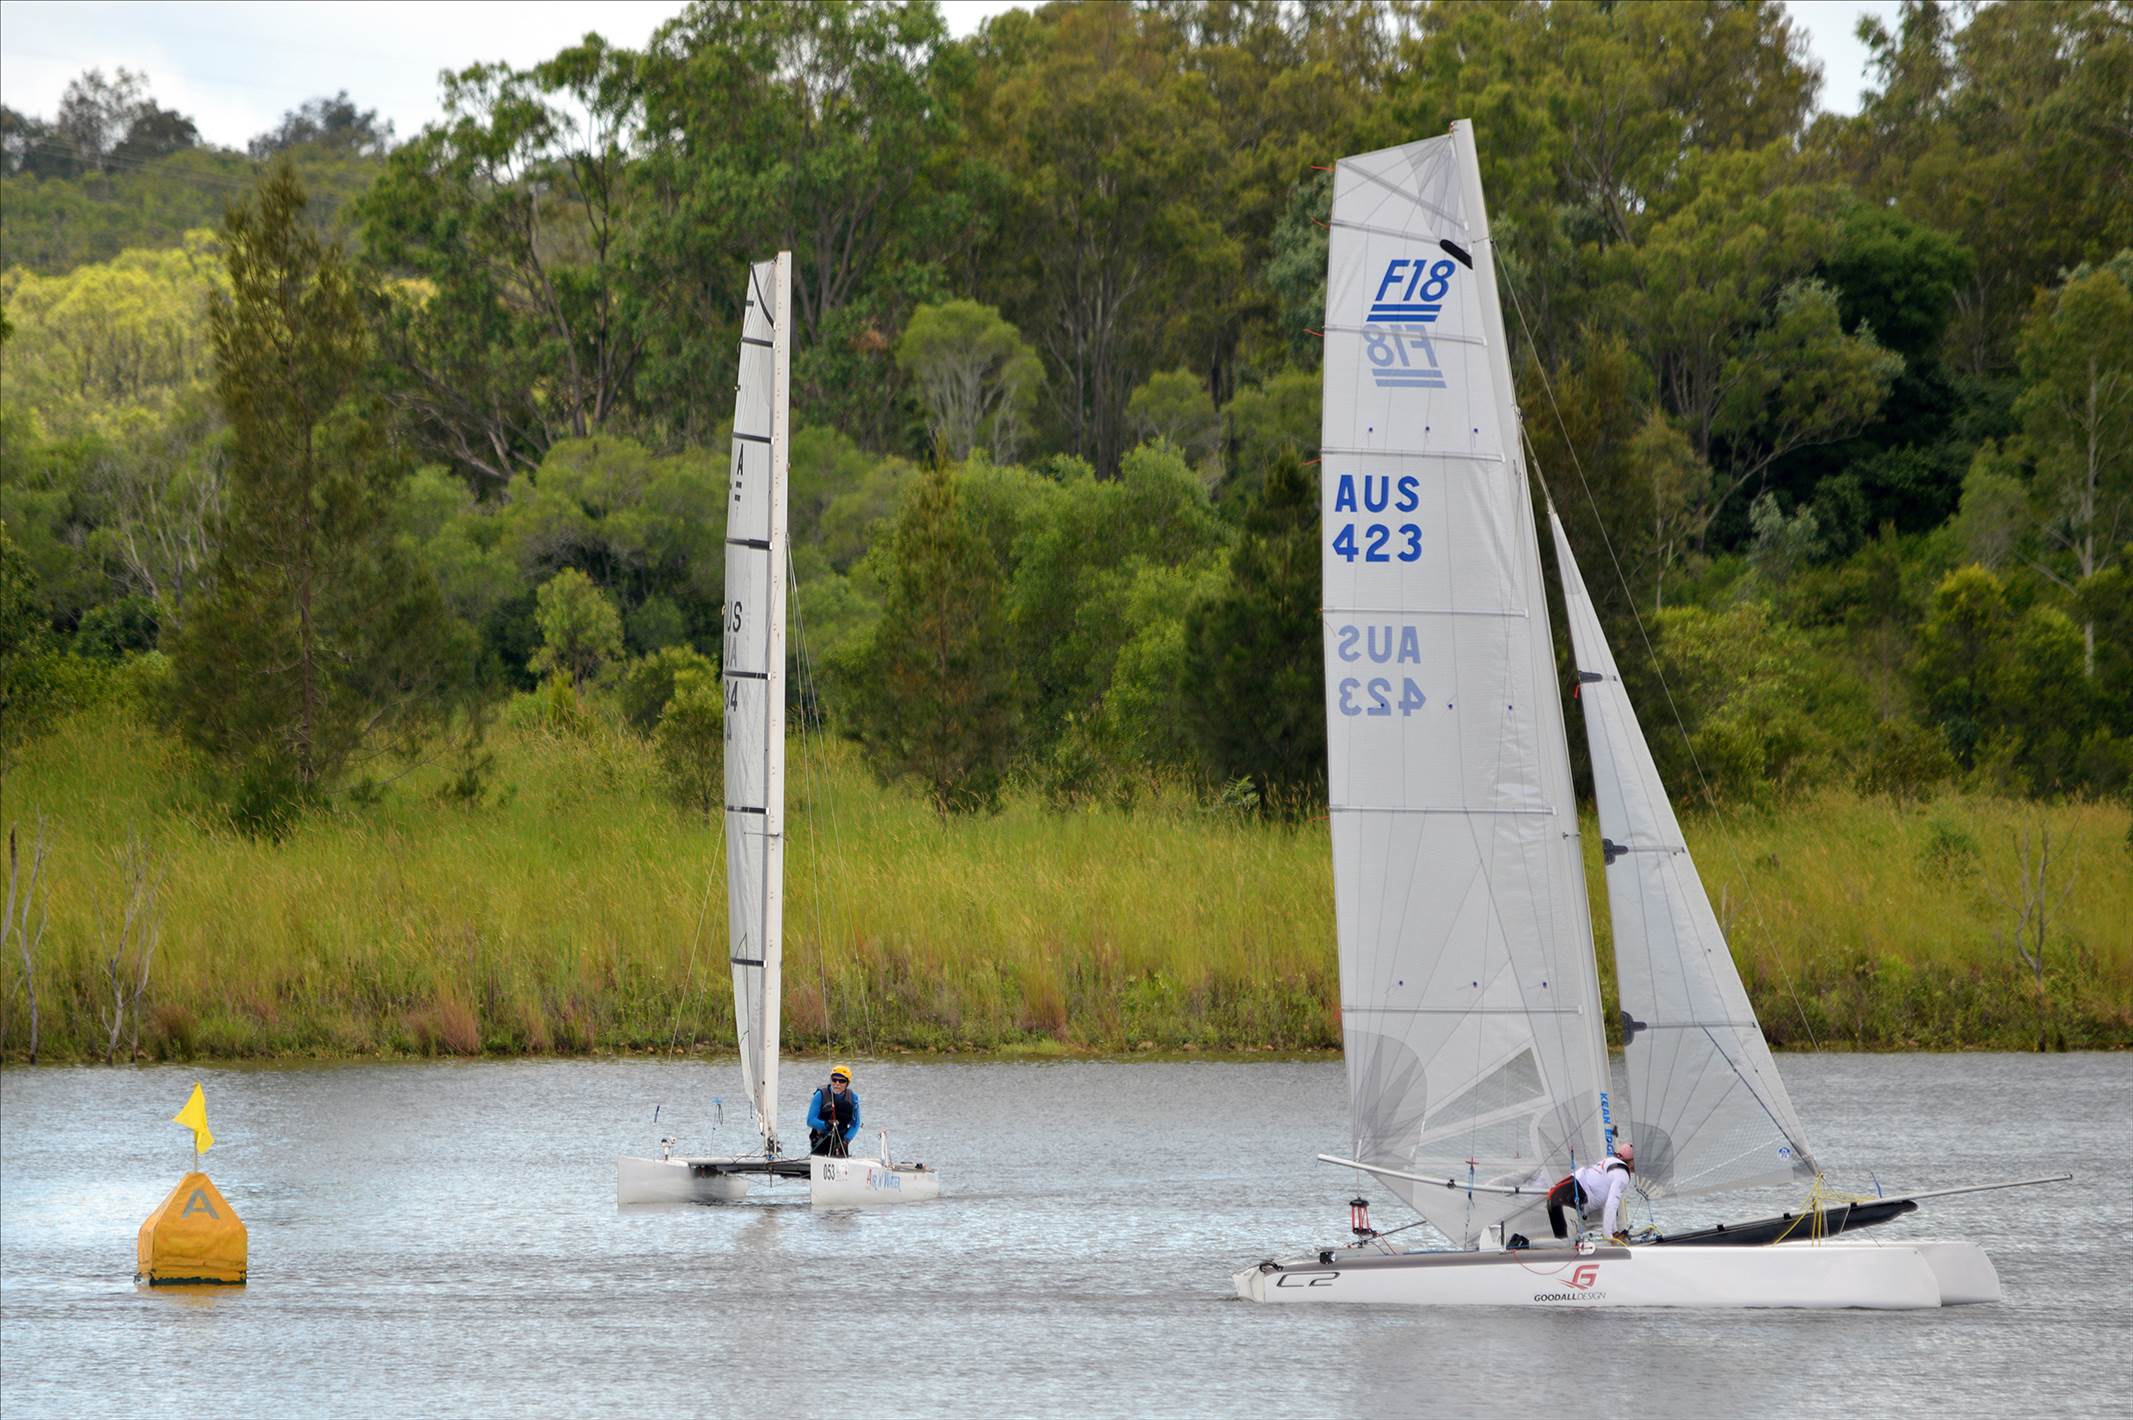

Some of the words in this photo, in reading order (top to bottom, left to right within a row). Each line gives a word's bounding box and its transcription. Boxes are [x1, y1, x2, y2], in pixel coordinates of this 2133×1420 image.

[1374, 259, 1456, 302] F18
[1335, 474, 1420, 513] AUS
[1332, 523, 1422, 562] 423
[1600, 1092, 1611, 1124] KEAN
[823, 1163, 836, 1181] 053
[180, 1187, 220, 1220] A
[1276, 1272, 1341, 1288] C2
